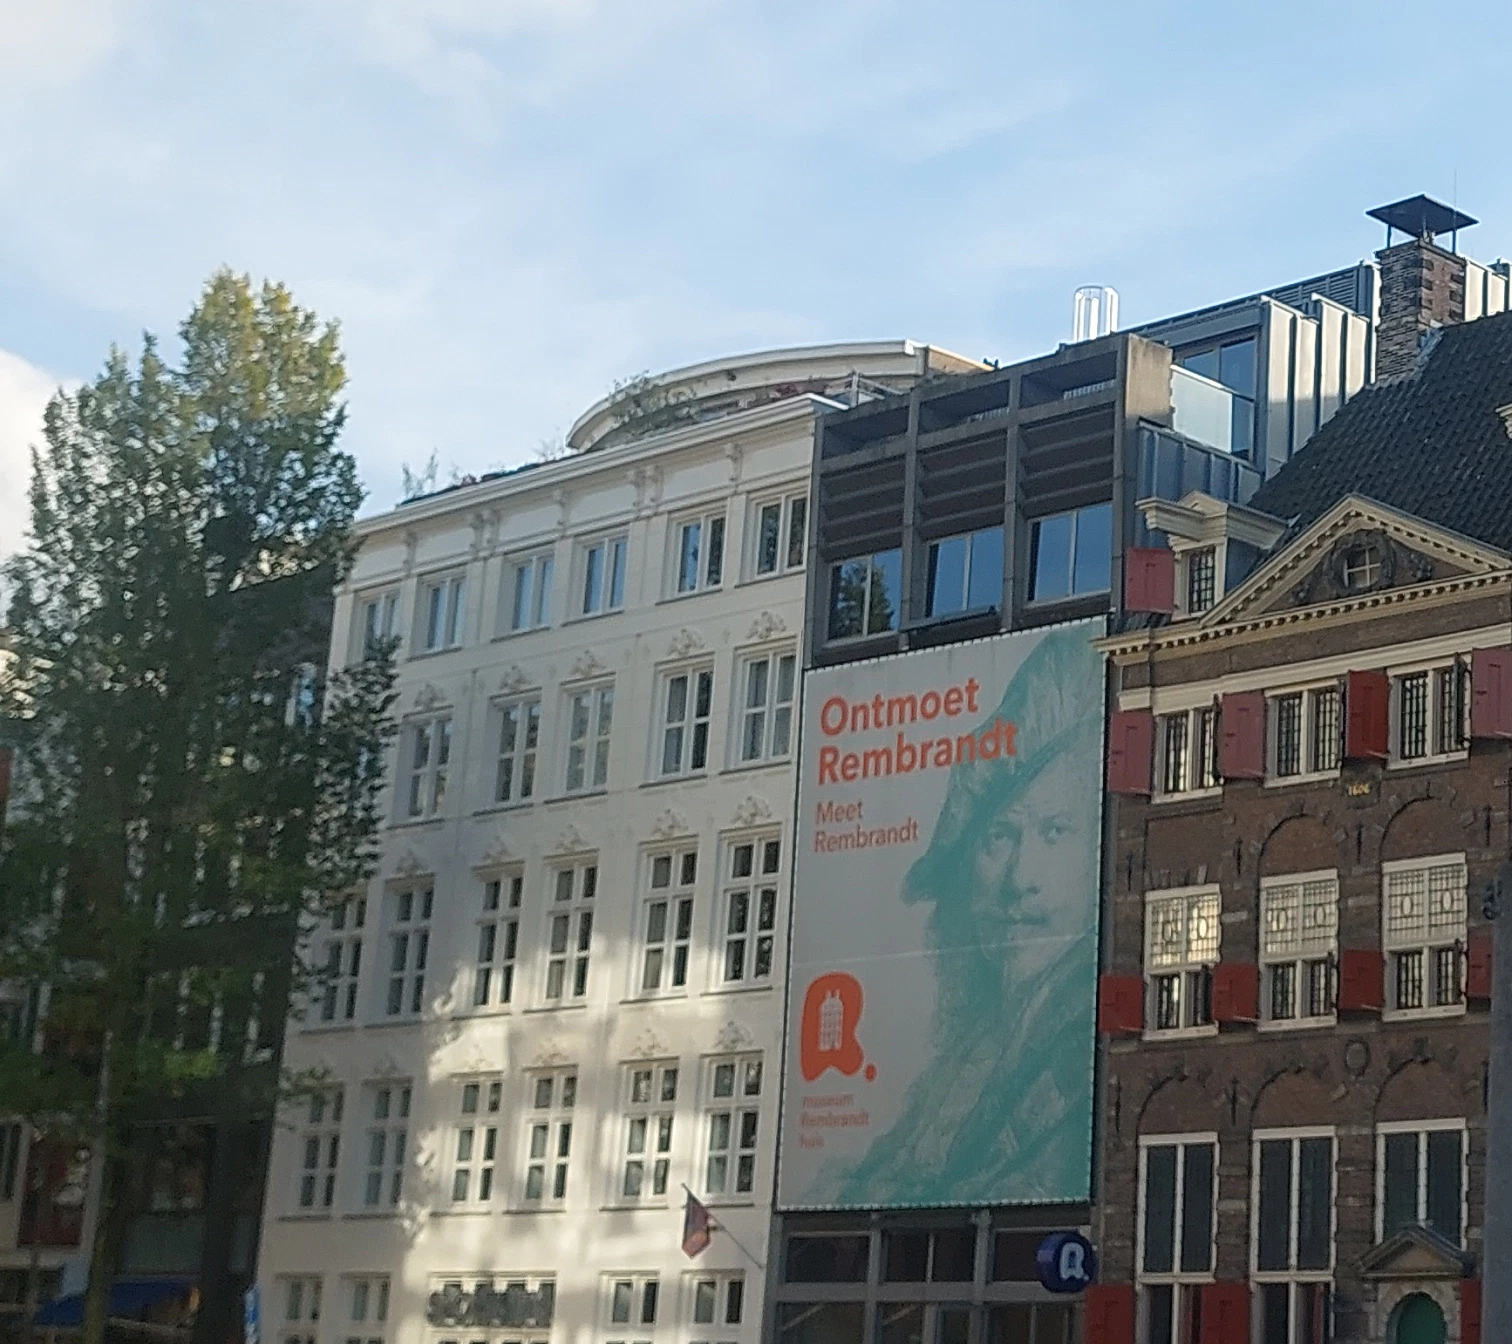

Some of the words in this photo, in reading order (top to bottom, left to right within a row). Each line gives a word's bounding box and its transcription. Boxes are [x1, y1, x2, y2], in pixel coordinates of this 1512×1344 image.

[820, 677, 980, 736] Ontmoet
[818, 717, 1019, 785] Rembrandt
[815, 798, 863, 825] Meet
[814, 817, 919, 853] Rembrandt
[802, 1094, 854, 1108] museum
